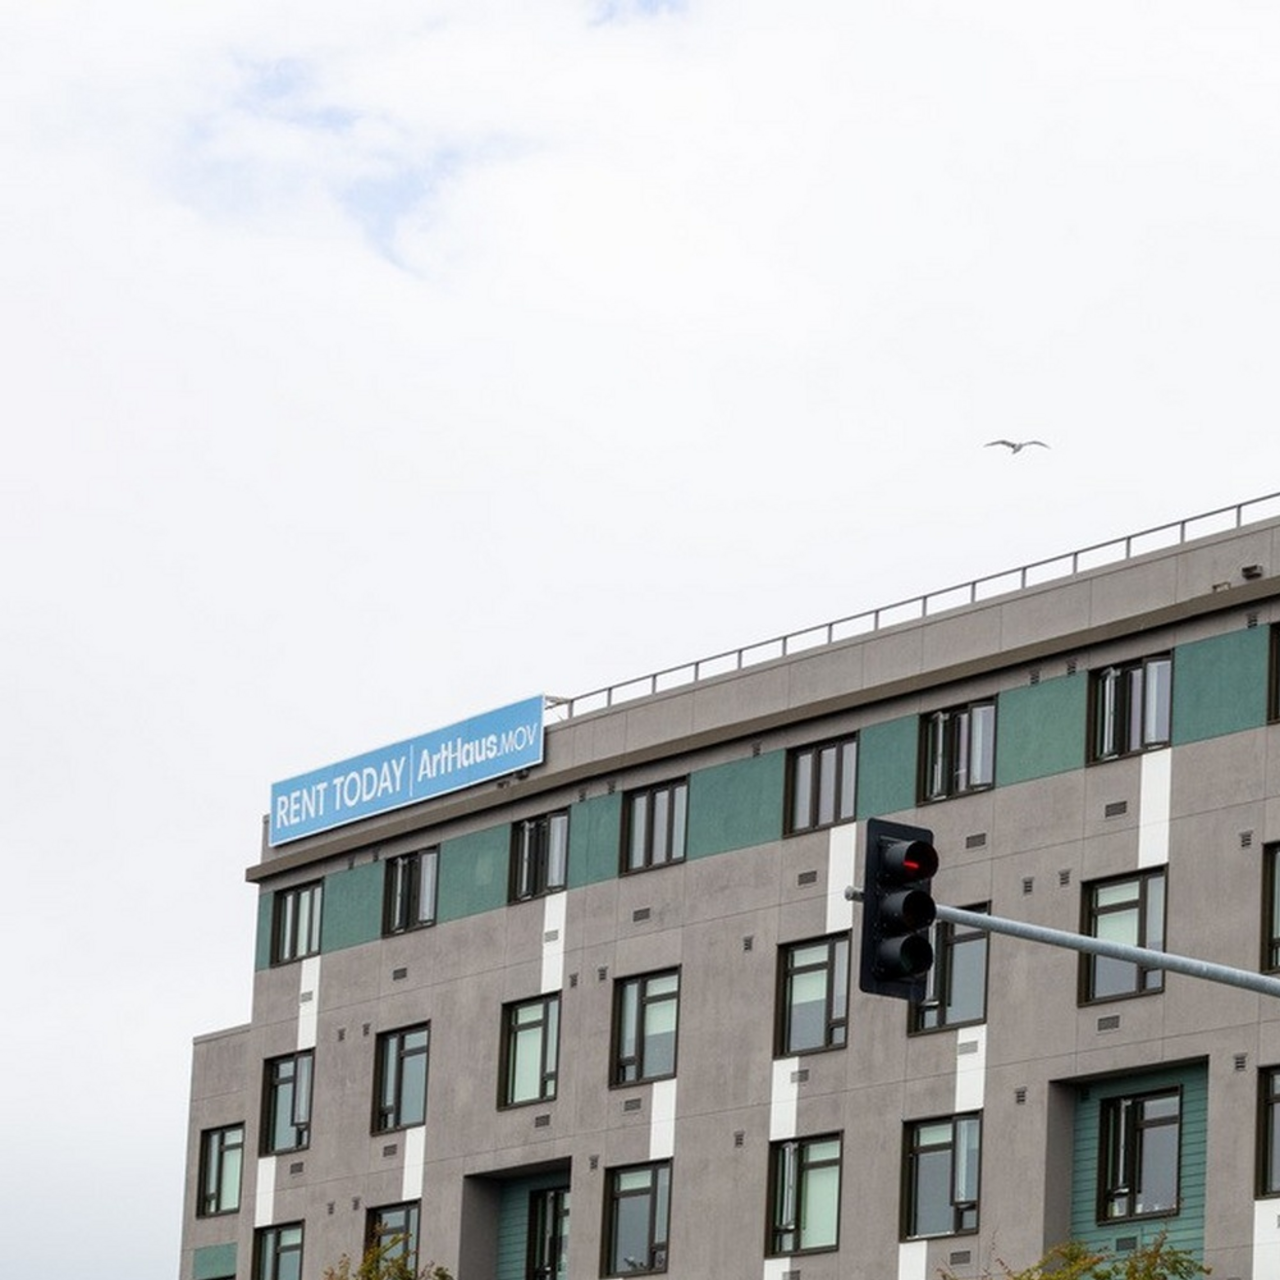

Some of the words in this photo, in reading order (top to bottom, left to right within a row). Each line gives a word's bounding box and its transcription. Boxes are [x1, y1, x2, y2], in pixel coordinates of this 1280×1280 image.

[277, 780, 328, 829] RENT
[333, 755, 406, 811] TODAY
[417, 722, 538, 782] ArtHaus.MOV
